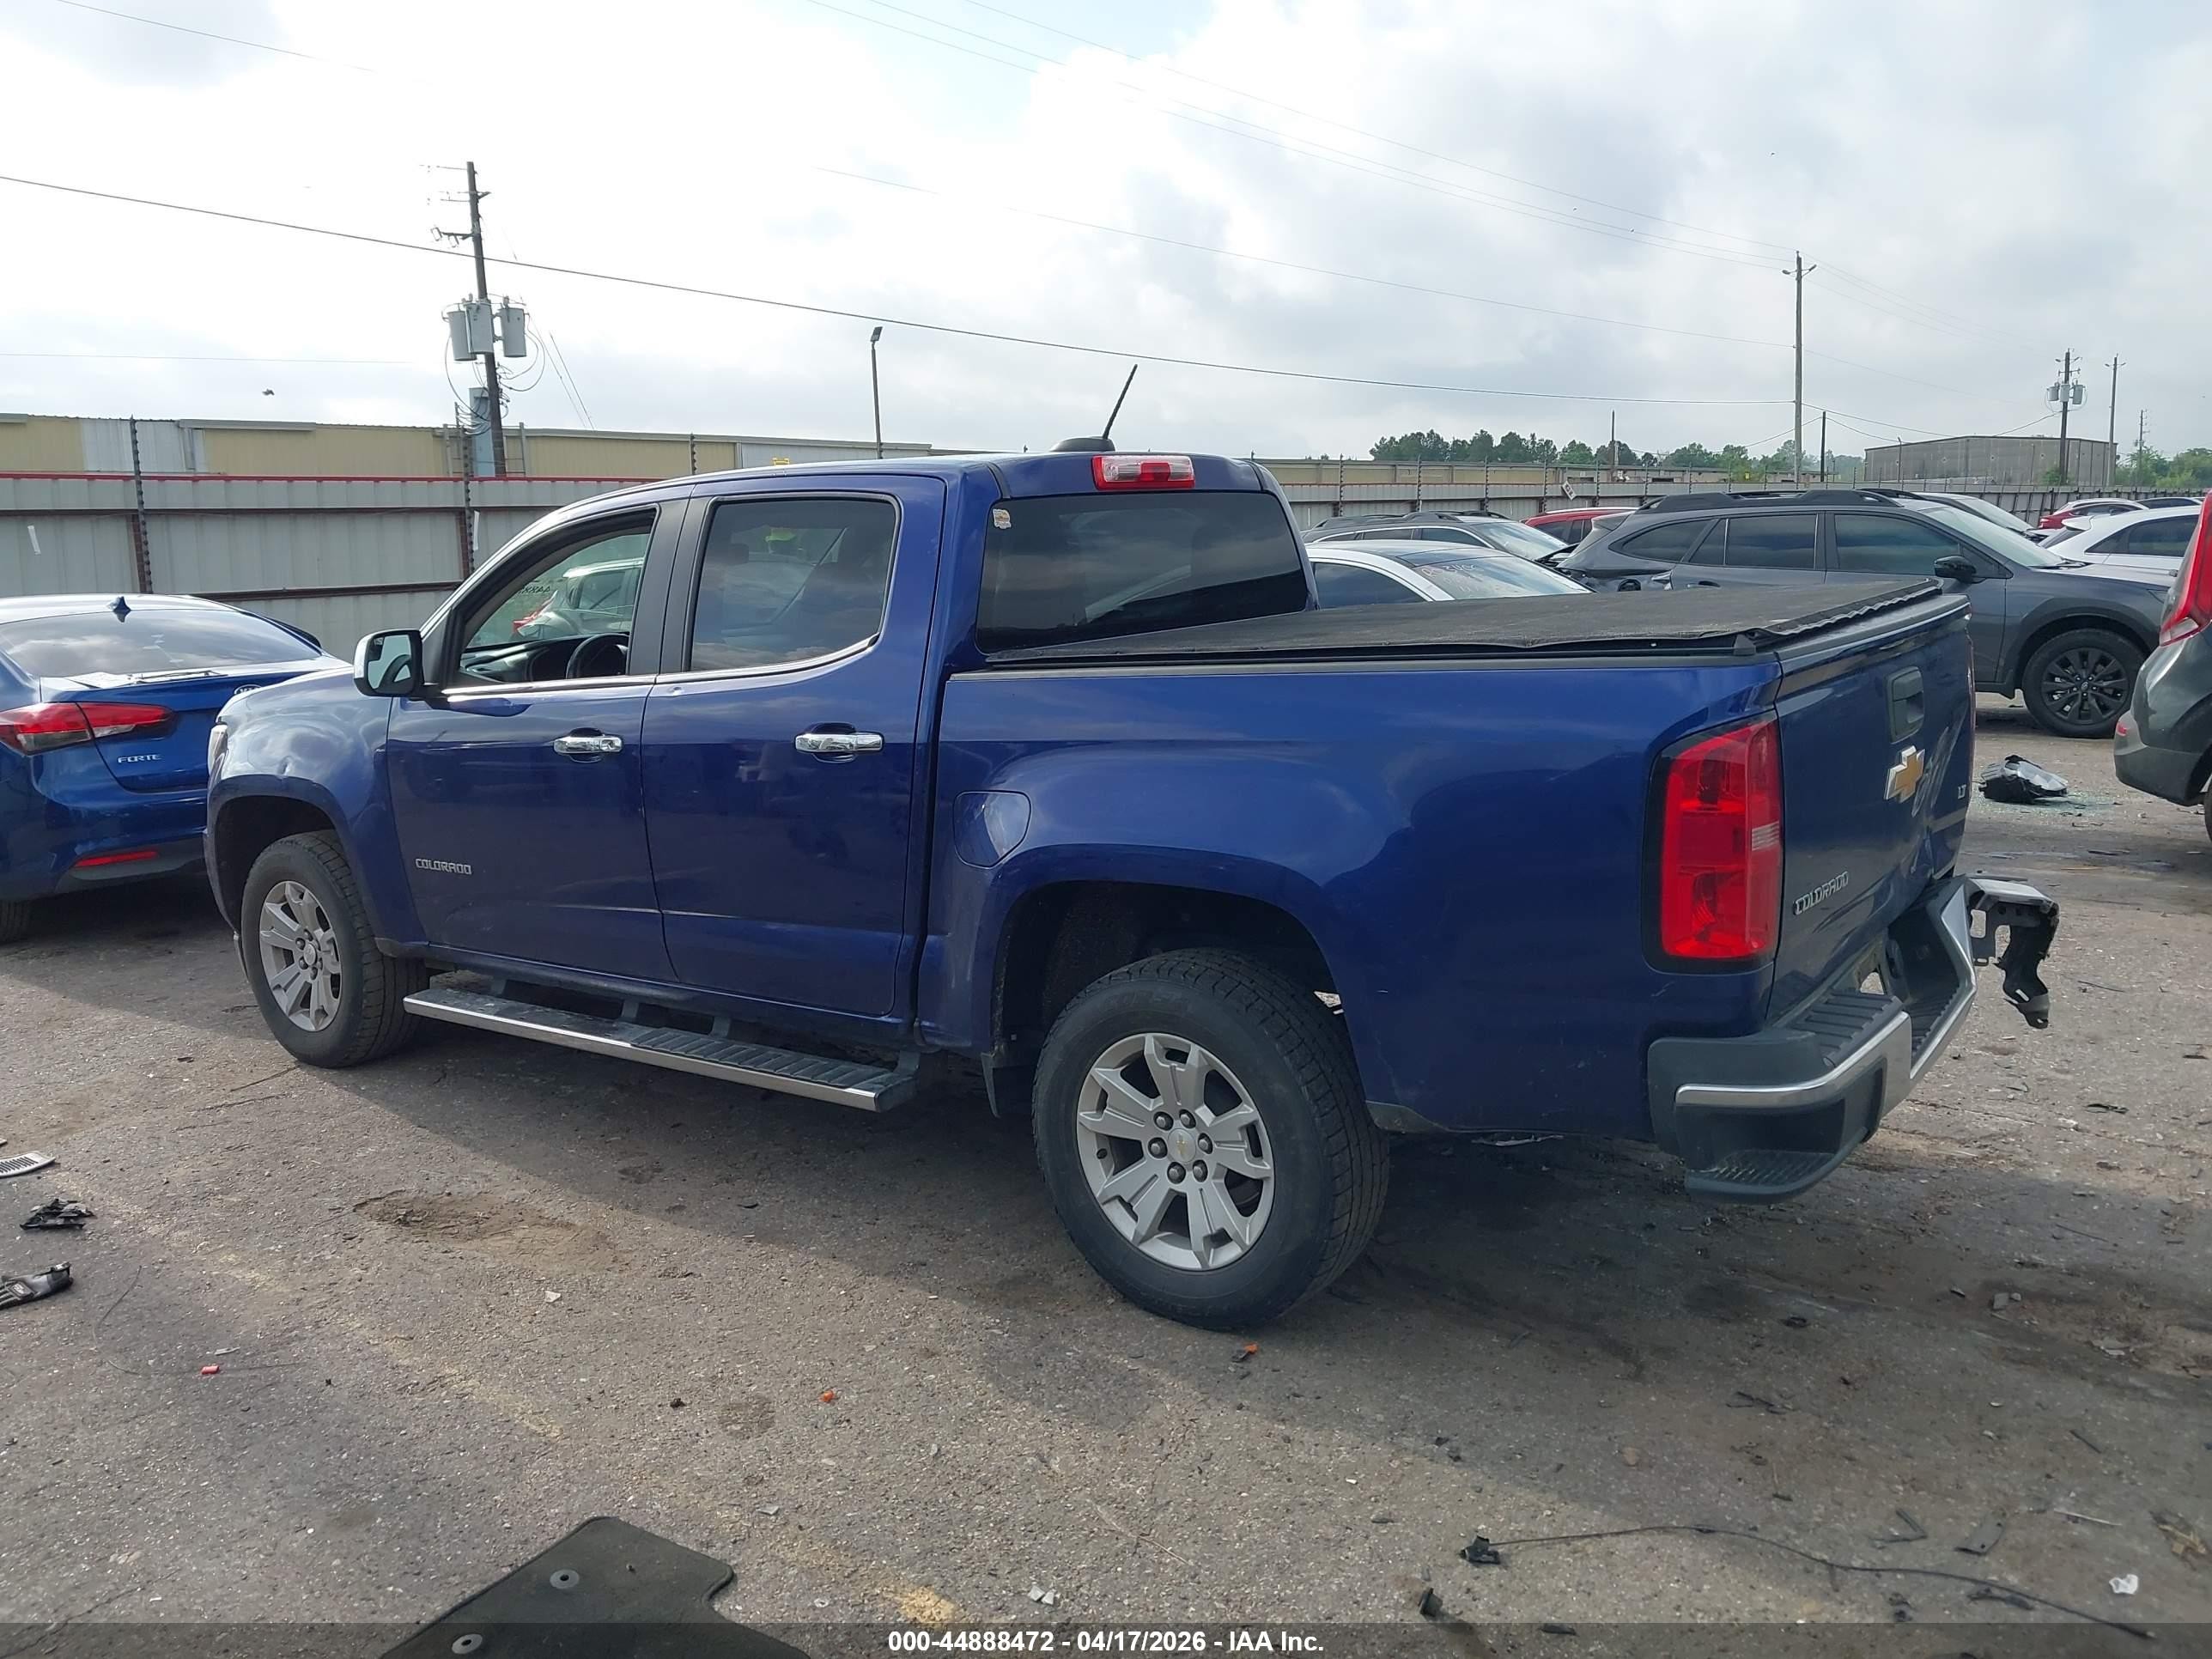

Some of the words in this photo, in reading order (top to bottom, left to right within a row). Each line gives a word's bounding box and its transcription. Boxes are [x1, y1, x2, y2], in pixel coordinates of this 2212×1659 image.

[118, 754, 161, 763] FORTE
[416, 858, 472, 875] COLORADO
[1794, 871, 1849, 915] COLORADO
